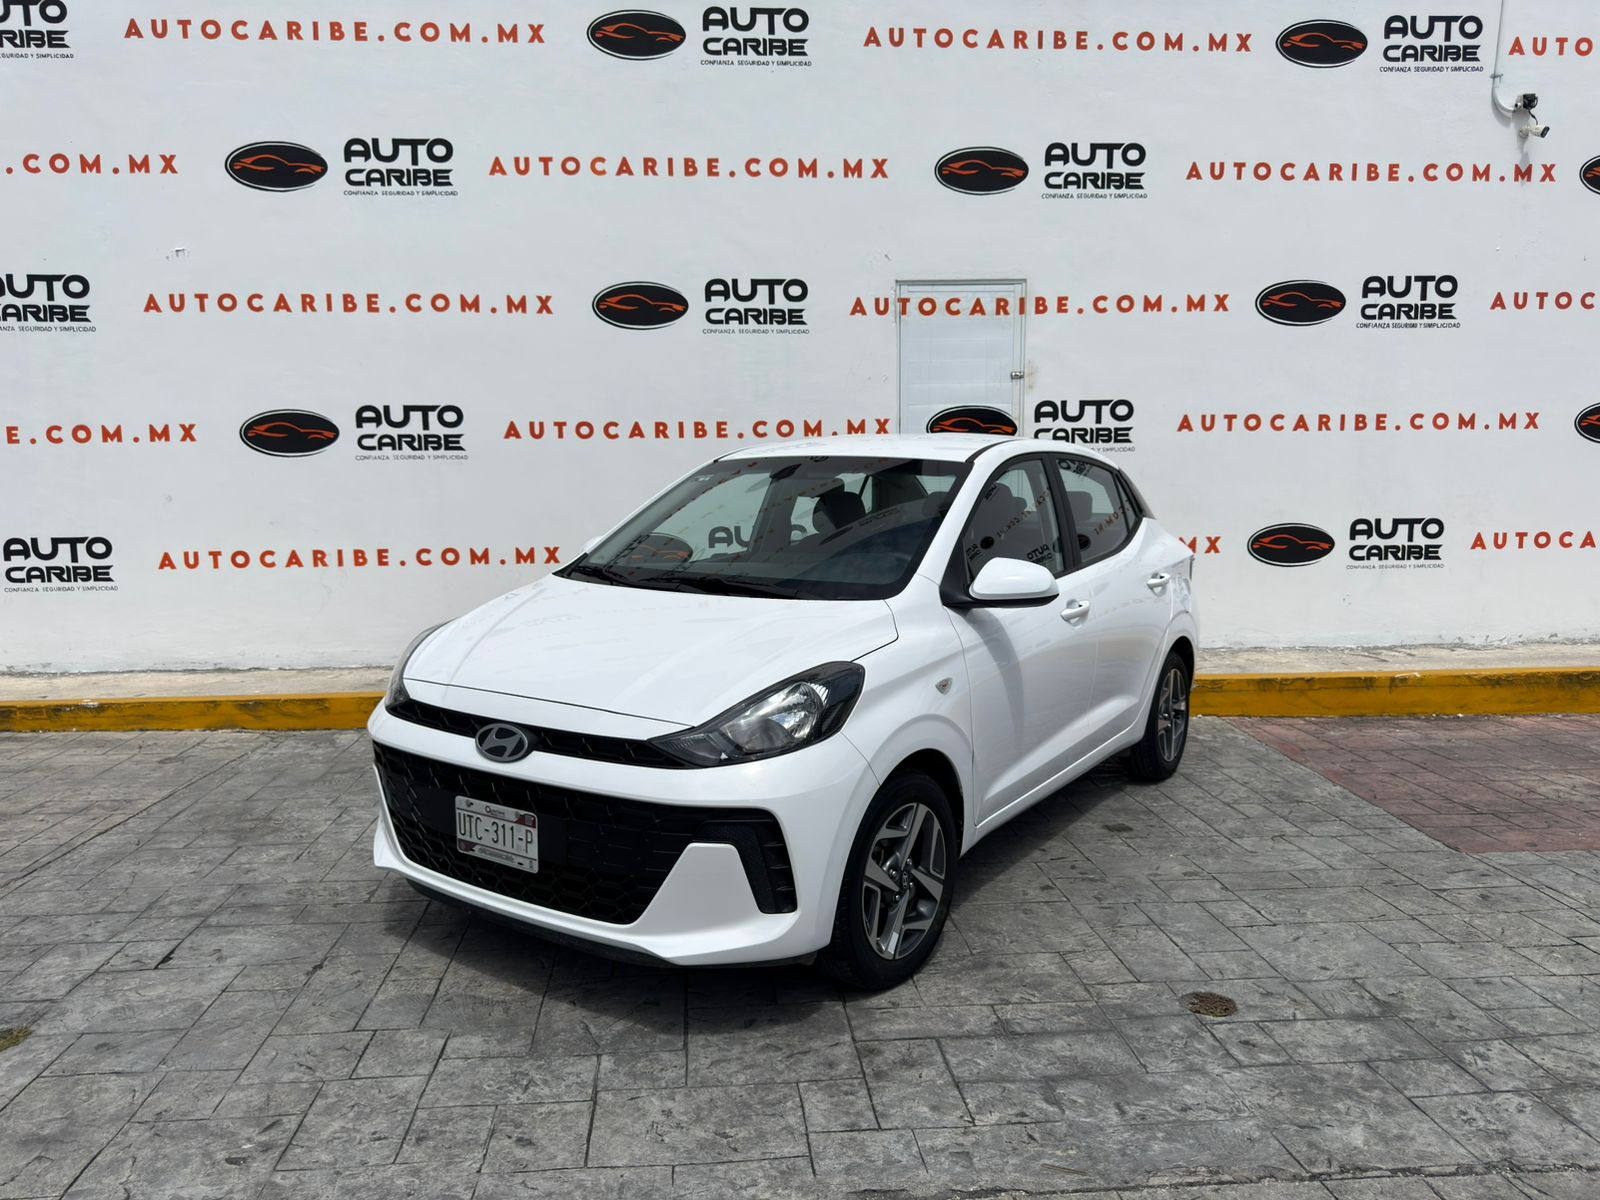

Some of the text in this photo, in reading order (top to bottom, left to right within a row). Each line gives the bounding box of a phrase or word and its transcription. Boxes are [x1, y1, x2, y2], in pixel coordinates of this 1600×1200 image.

[124, 18, 545, 43] AUTOCARIBE.COM.MX
[703, 6, 810, 35] AUTO
[1384, 15, 1483, 42] AUTO
[703, 37, 809, 57] CARIBE
[864, 27, 1252, 52] AUTOCARIBE.COM.MX
[1510, 36, 1594, 57] AUTO
[1382, 44, 1481, 63] CARIBE
[344, 138, 454, 166] AUTO
[1045, 142, 1147, 169] AUTO
[345, 169, 453, 187] CARIBE
[490, 156, 890, 179] AUTOCARIBE.COM.MX
[1187, 162, 1556, 182] AUTOCARIBE.COM.MX
[1045, 172, 1145, 190] CARIBE
[0, 273, 90, 302] UTO
[705, 278, 809, 304] AUTO
[1362, 274, 1458, 301] AUTO
[145, 293, 553, 314] AUTOCARIBE.COM.MX
[850, 294, 1230, 317] AUTOCARIBE.COM.MX
[1360, 303, 1457, 320] CARIBE
[1490, 292, 1596, 310] AUTOC
[705, 307, 808, 325] CARIBE
[356, 405, 464, 430] AUTO
[1034, 399, 1135, 424] AUTO
[1178, 412, 1540, 432] AUTOCARIBE.COM.MX
[6, 423, 196, 445] E.COM.MX
[505, 418, 890, 441] AUTOCARIBE.COM.MX
[357, 434, 466, 452] CARIBE
[1350, 517, 1445, 543] AUTO
[1471, 531, 1597, 550] AUTOCA
[3, 537, 113, 563] AUTO
[159, 547, 561, 570] AUTOCARIBE.COM.MX
[1348, 545, 1443, 561] CARIBE
[5, 565, 114, 584] CARIBE
[458, 812, 533, 854] UTC-311-P
